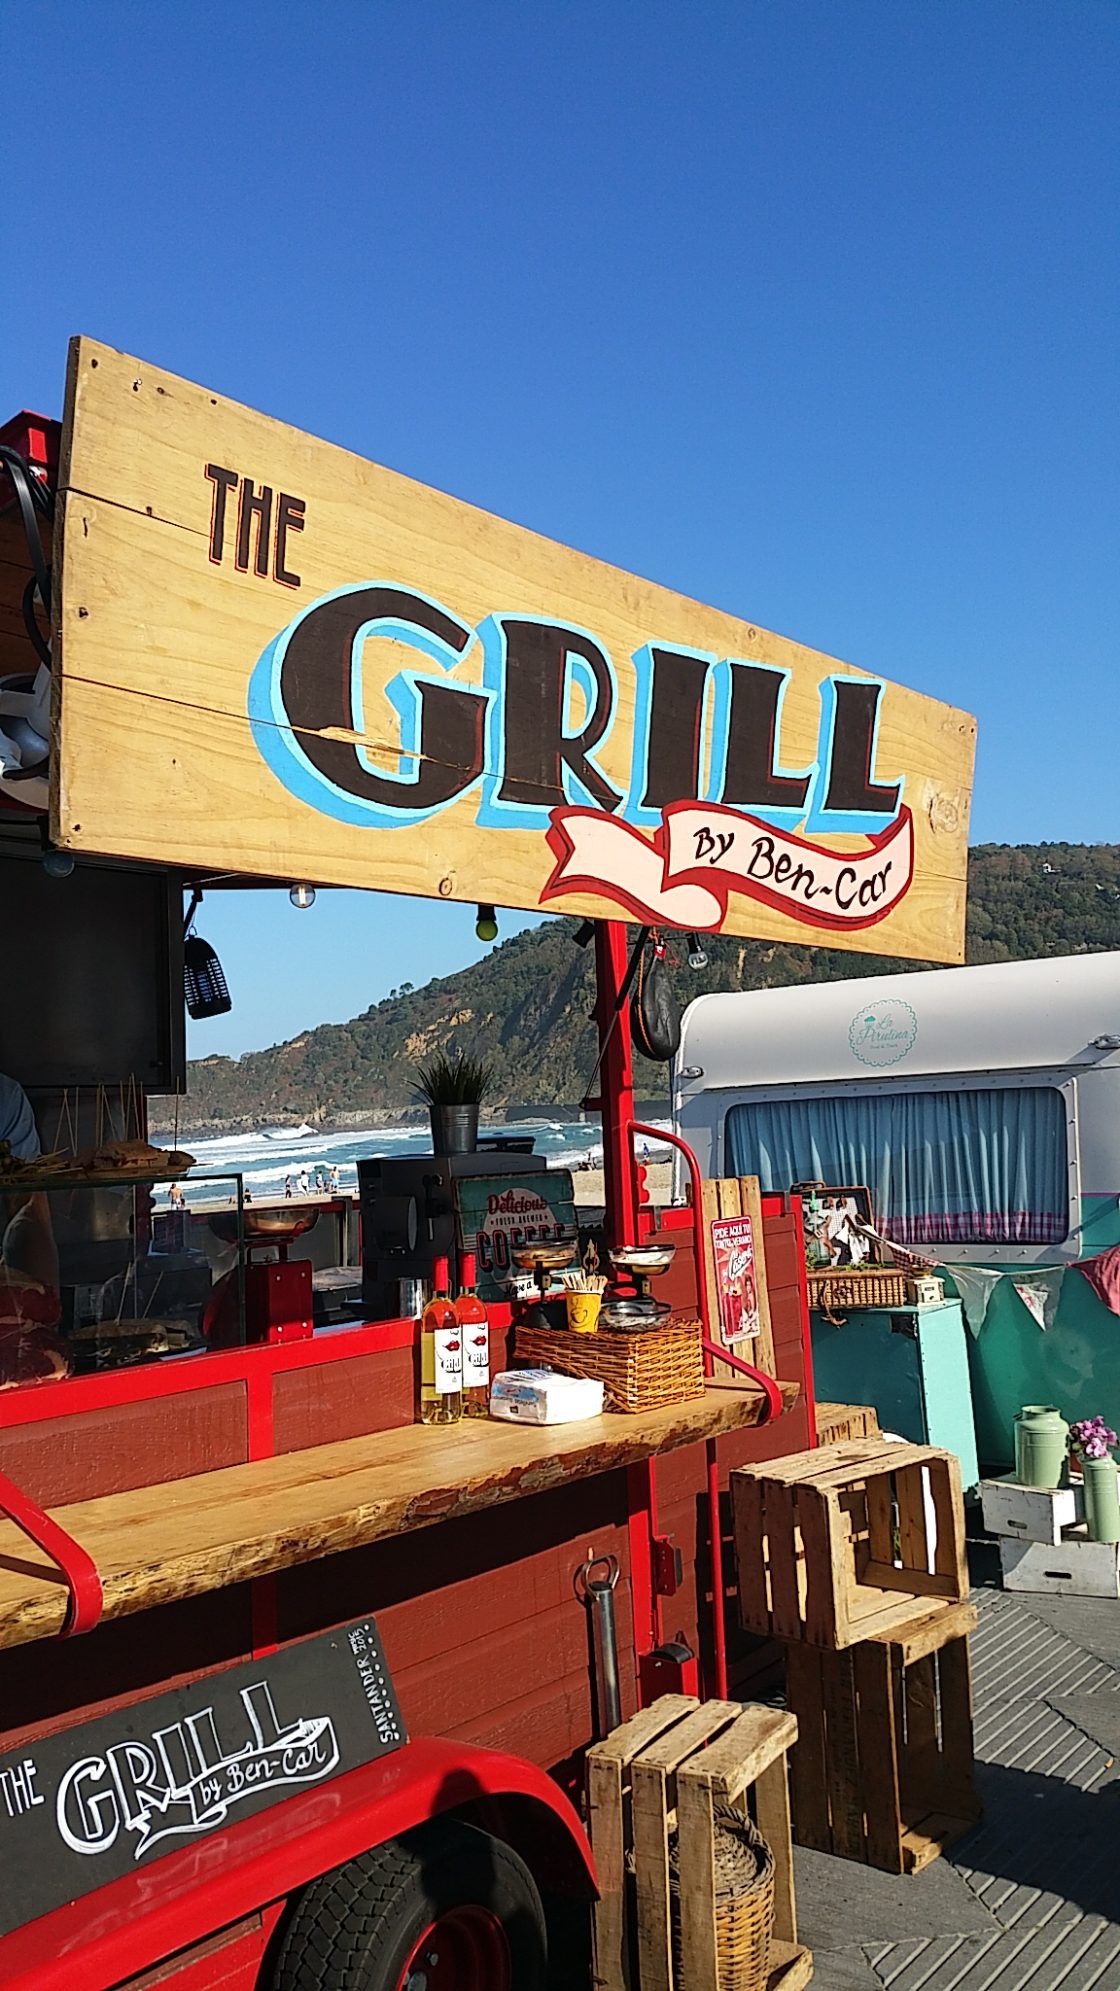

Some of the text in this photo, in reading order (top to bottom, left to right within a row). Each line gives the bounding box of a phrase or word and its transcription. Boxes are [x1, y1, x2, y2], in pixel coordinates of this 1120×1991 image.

[204, 463, 306, 590] THE
[250, 581, 905, 832] GRILL
[693, 826, 892, 910] By Ben-Car
[714, 1227, 729, 1239] PIDE
[354, 1628, 367, 1652] 2015
[356, 1654, 394, 1743] SANTANDER
[0, 1759, 45, 1817] THE
[57, 1680, 304, 1856] GRILL
[227, 1740, 328, 1793] Ben-Car
